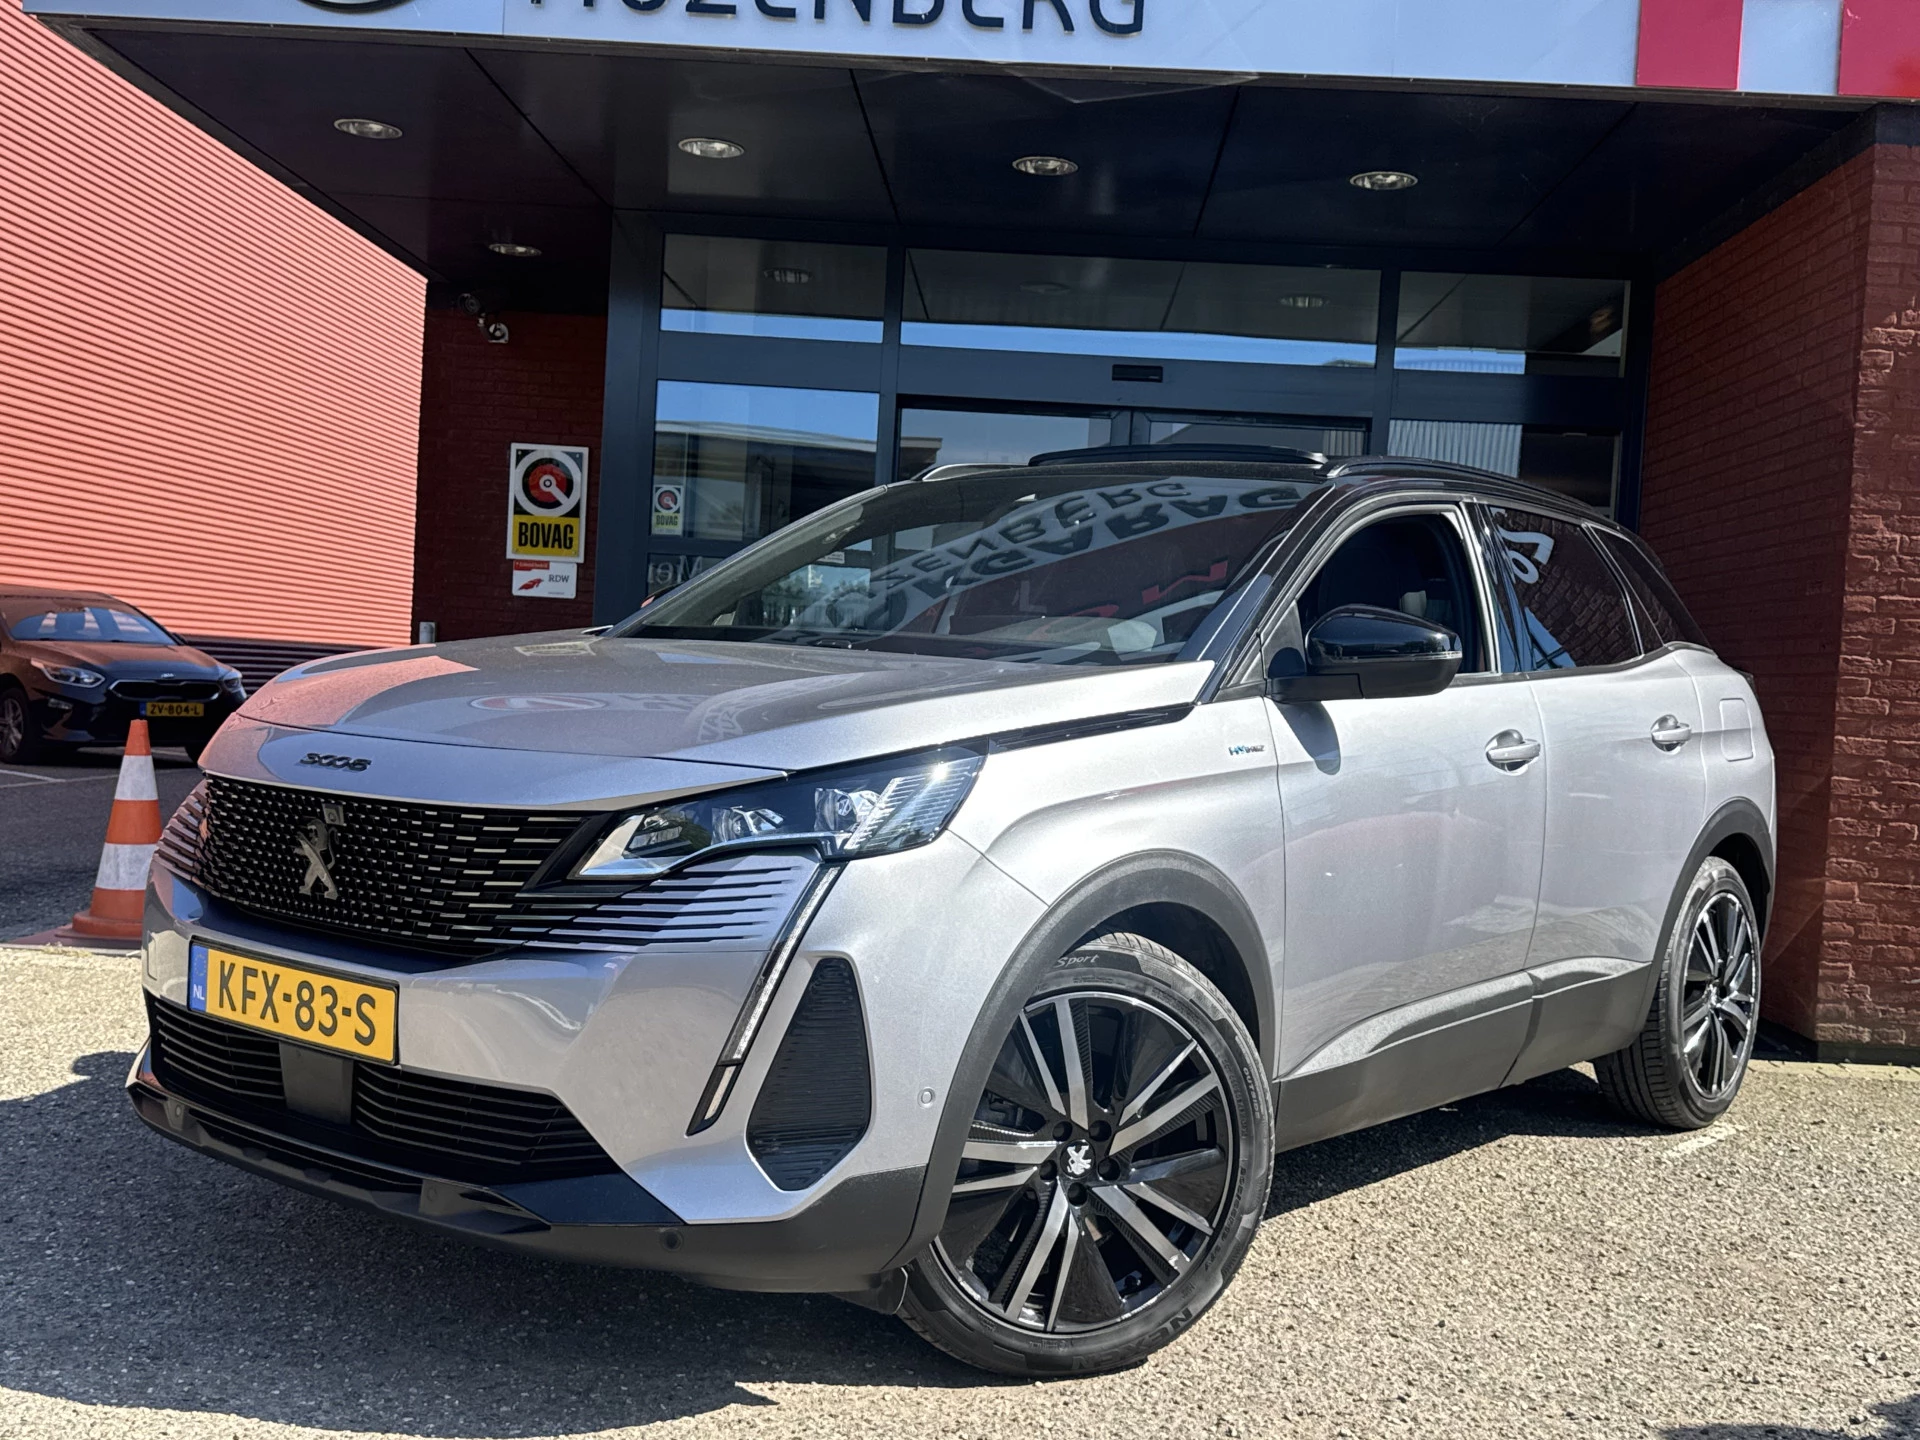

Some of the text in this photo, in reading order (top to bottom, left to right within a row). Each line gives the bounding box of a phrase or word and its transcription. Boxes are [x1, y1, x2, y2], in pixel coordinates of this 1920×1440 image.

[655, 514, 679, 527] BOVAG
[518, 522, 574, 549] BOVAG
[548, 574, 570, 583] RDW
[1053, 954, 1100, 968] Sport
[193, 984, 205, 1000] NL
[219, 960, 376, 1046] KFX-83-S
[1243, 1067, 1261, 1119] OUTSIDE
[1071, 1307, 1193, 1370] NEXEN
